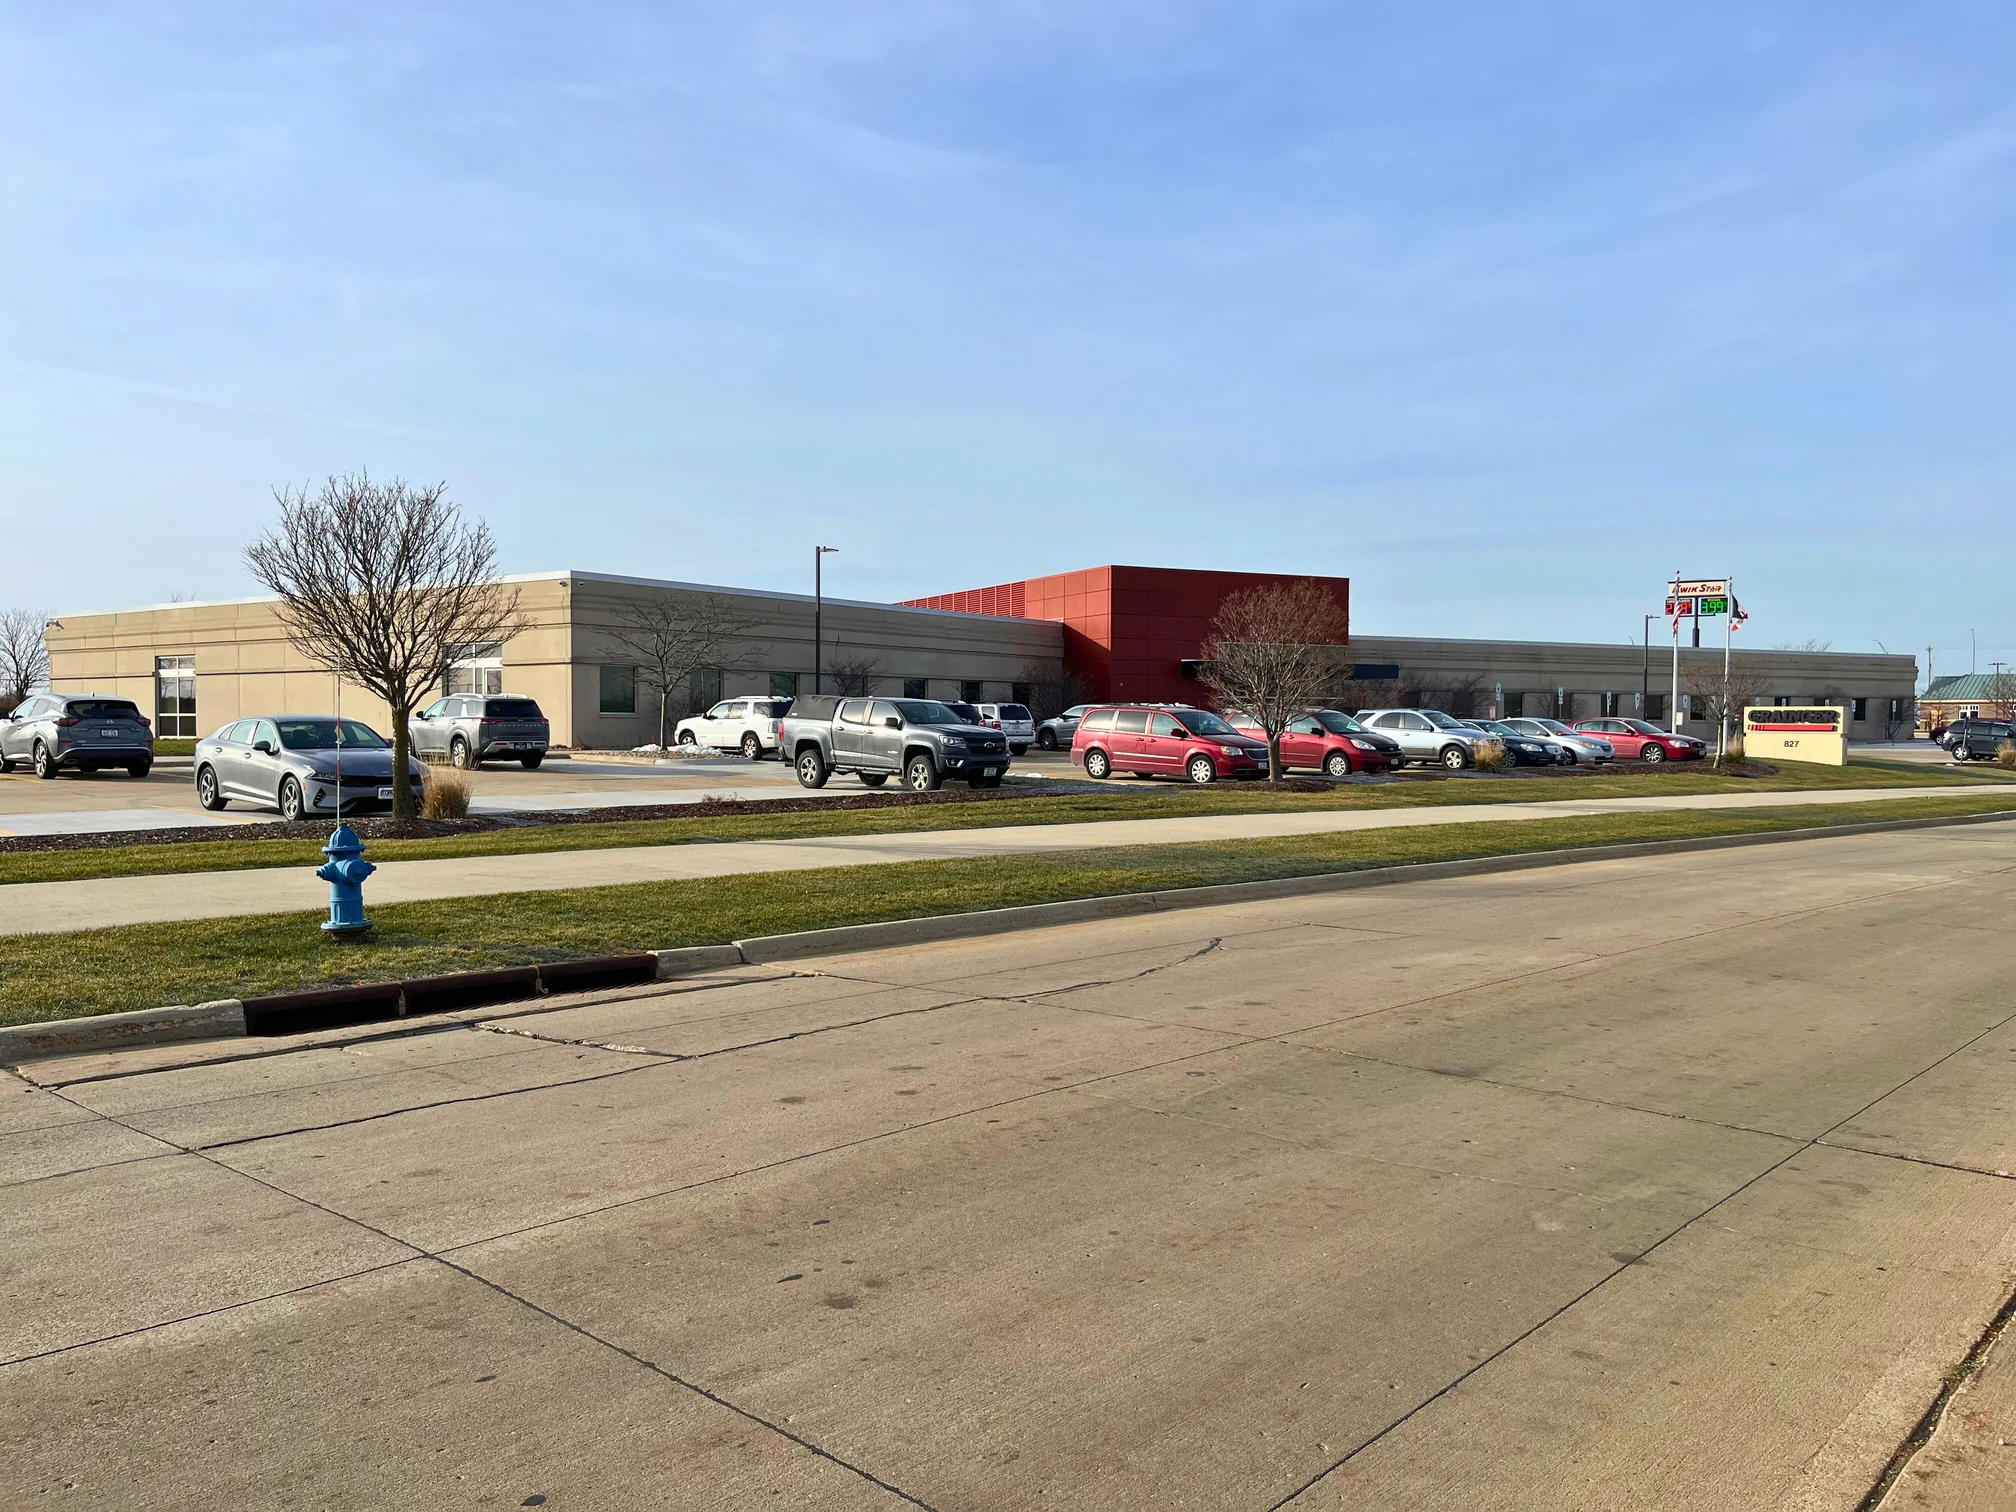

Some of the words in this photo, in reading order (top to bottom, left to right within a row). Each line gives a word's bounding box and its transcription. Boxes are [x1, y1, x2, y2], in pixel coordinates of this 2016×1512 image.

[1699, 584, 1722, 592] STAR
[1748, 710, 1839, 724] GRAINGER
[1784, 740, 1799, 748] 827
